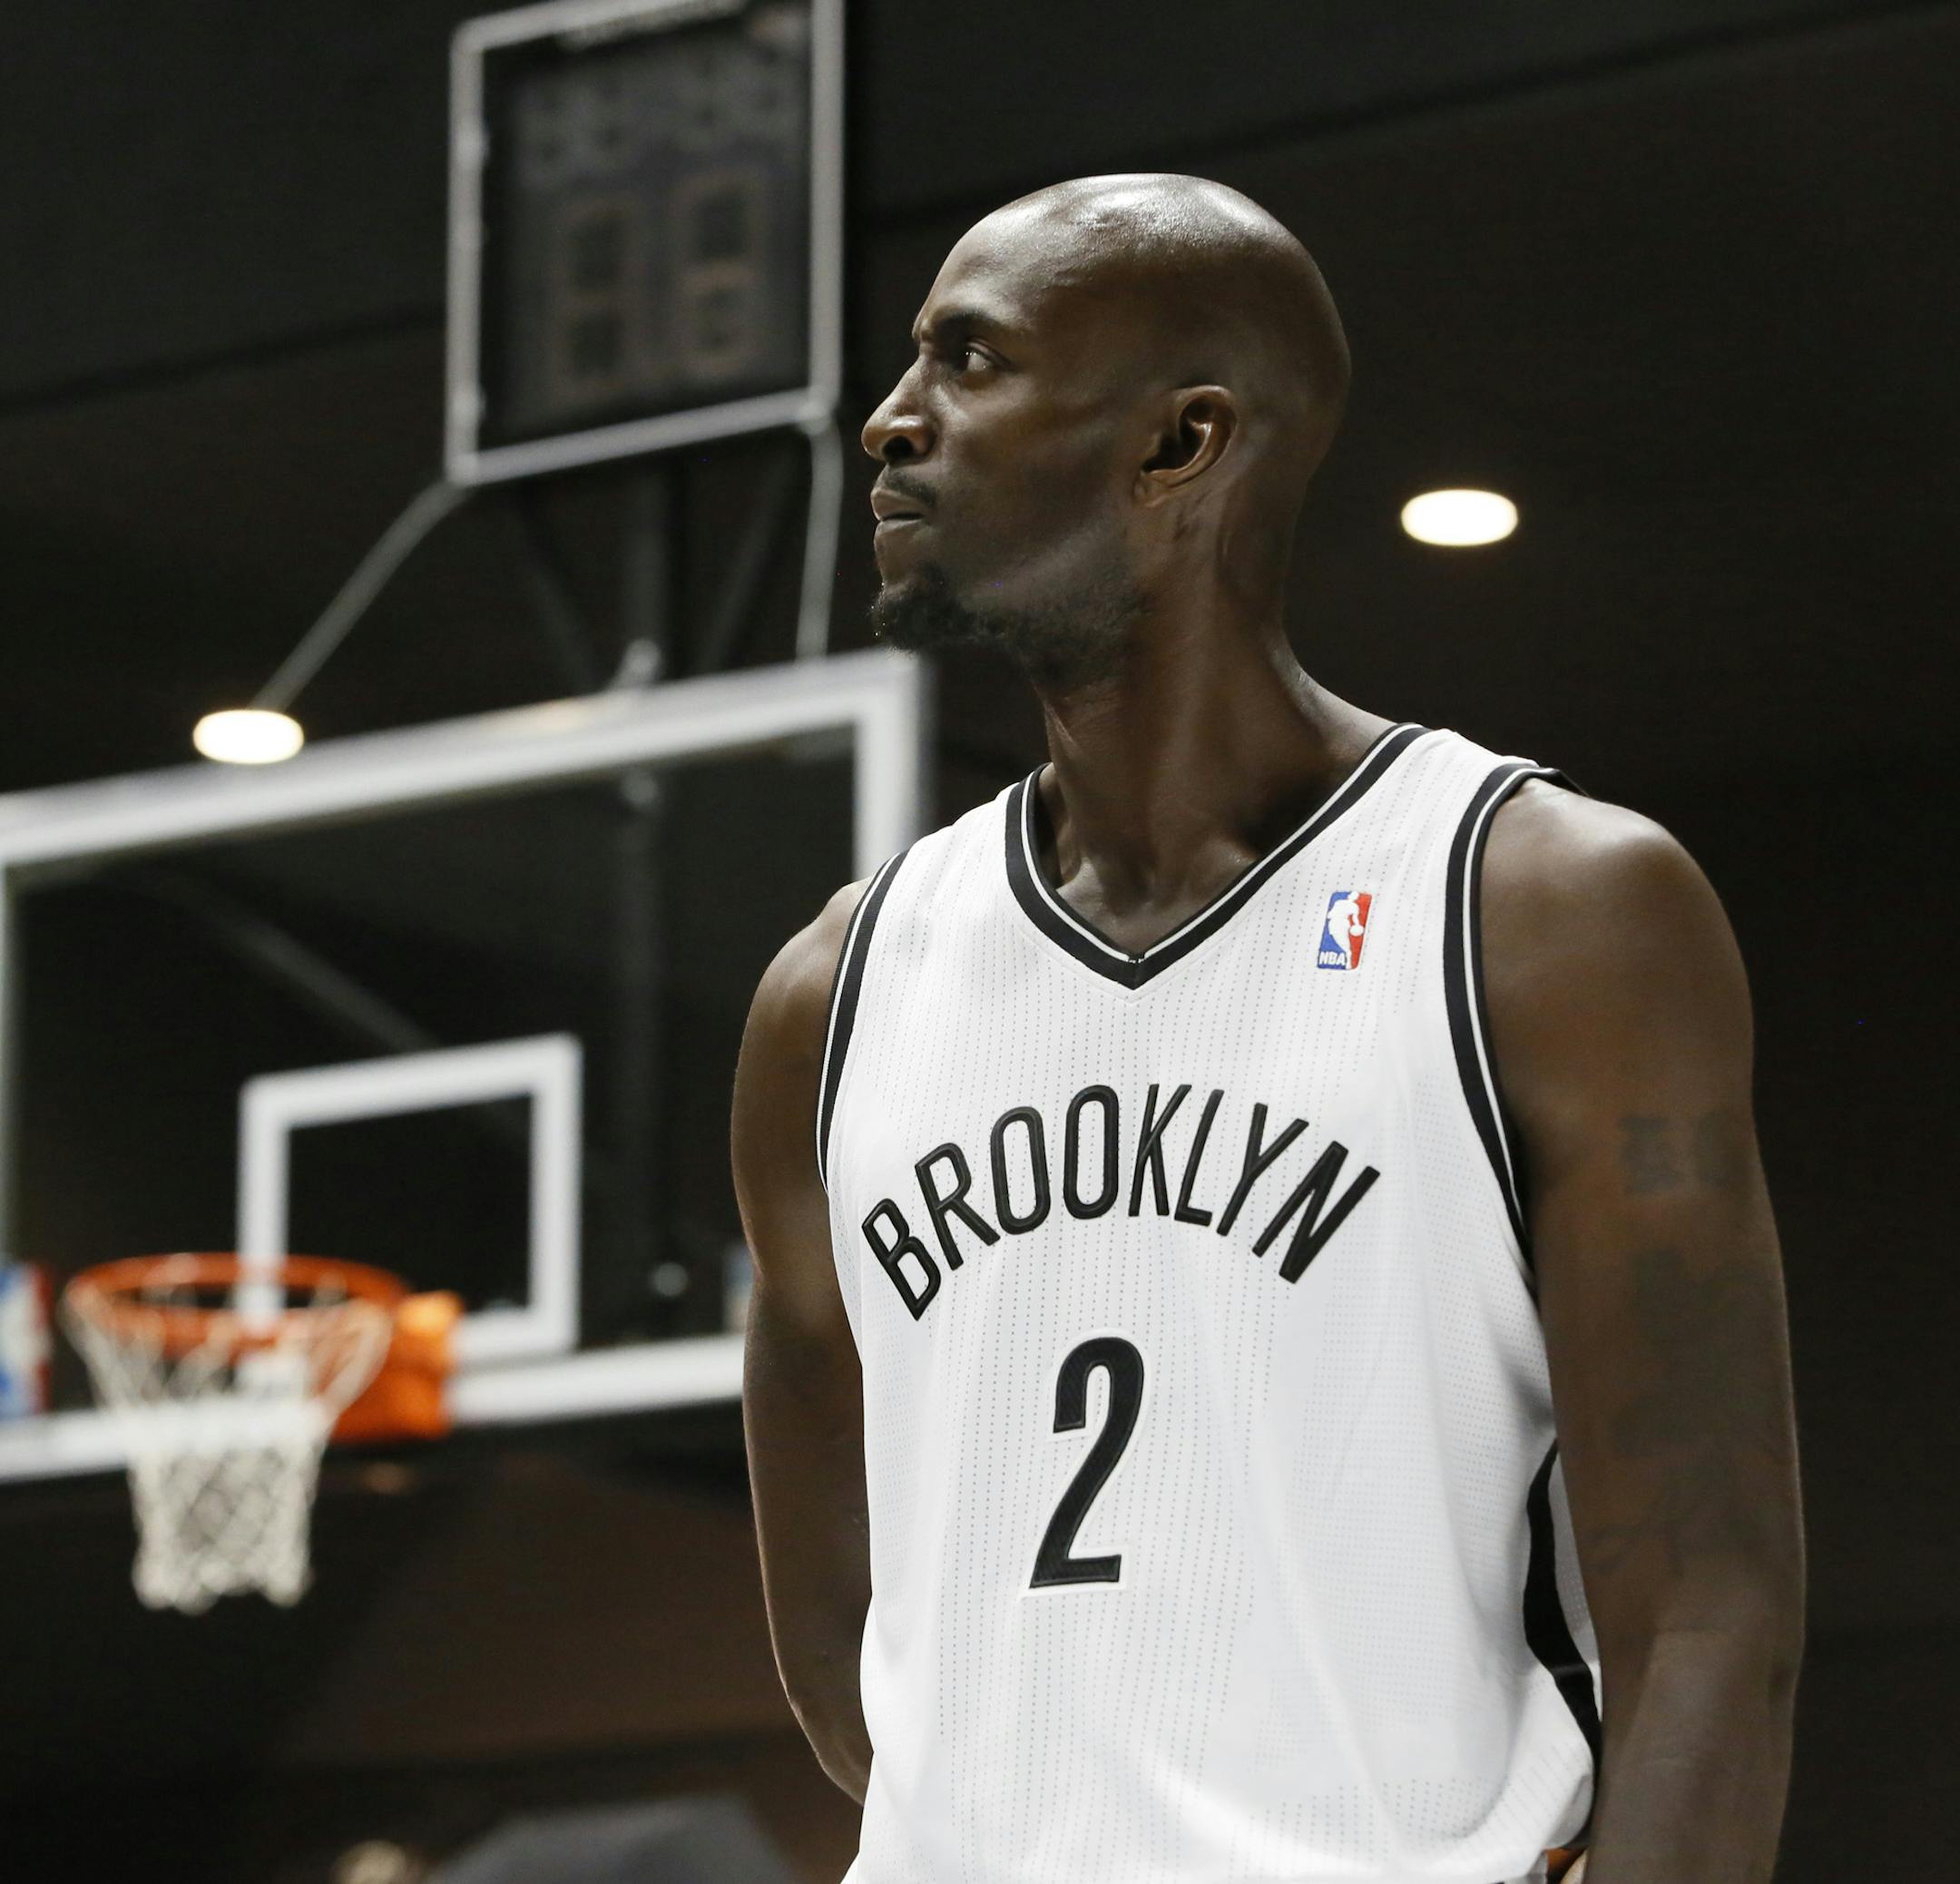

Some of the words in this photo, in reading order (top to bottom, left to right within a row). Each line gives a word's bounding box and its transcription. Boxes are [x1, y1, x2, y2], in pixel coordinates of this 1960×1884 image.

[1319, 951, 1346, 966] NBA
[861, 1084, 1381, 1321] BROOKLYN
[1029, 1336, 1145, 1590] 2
